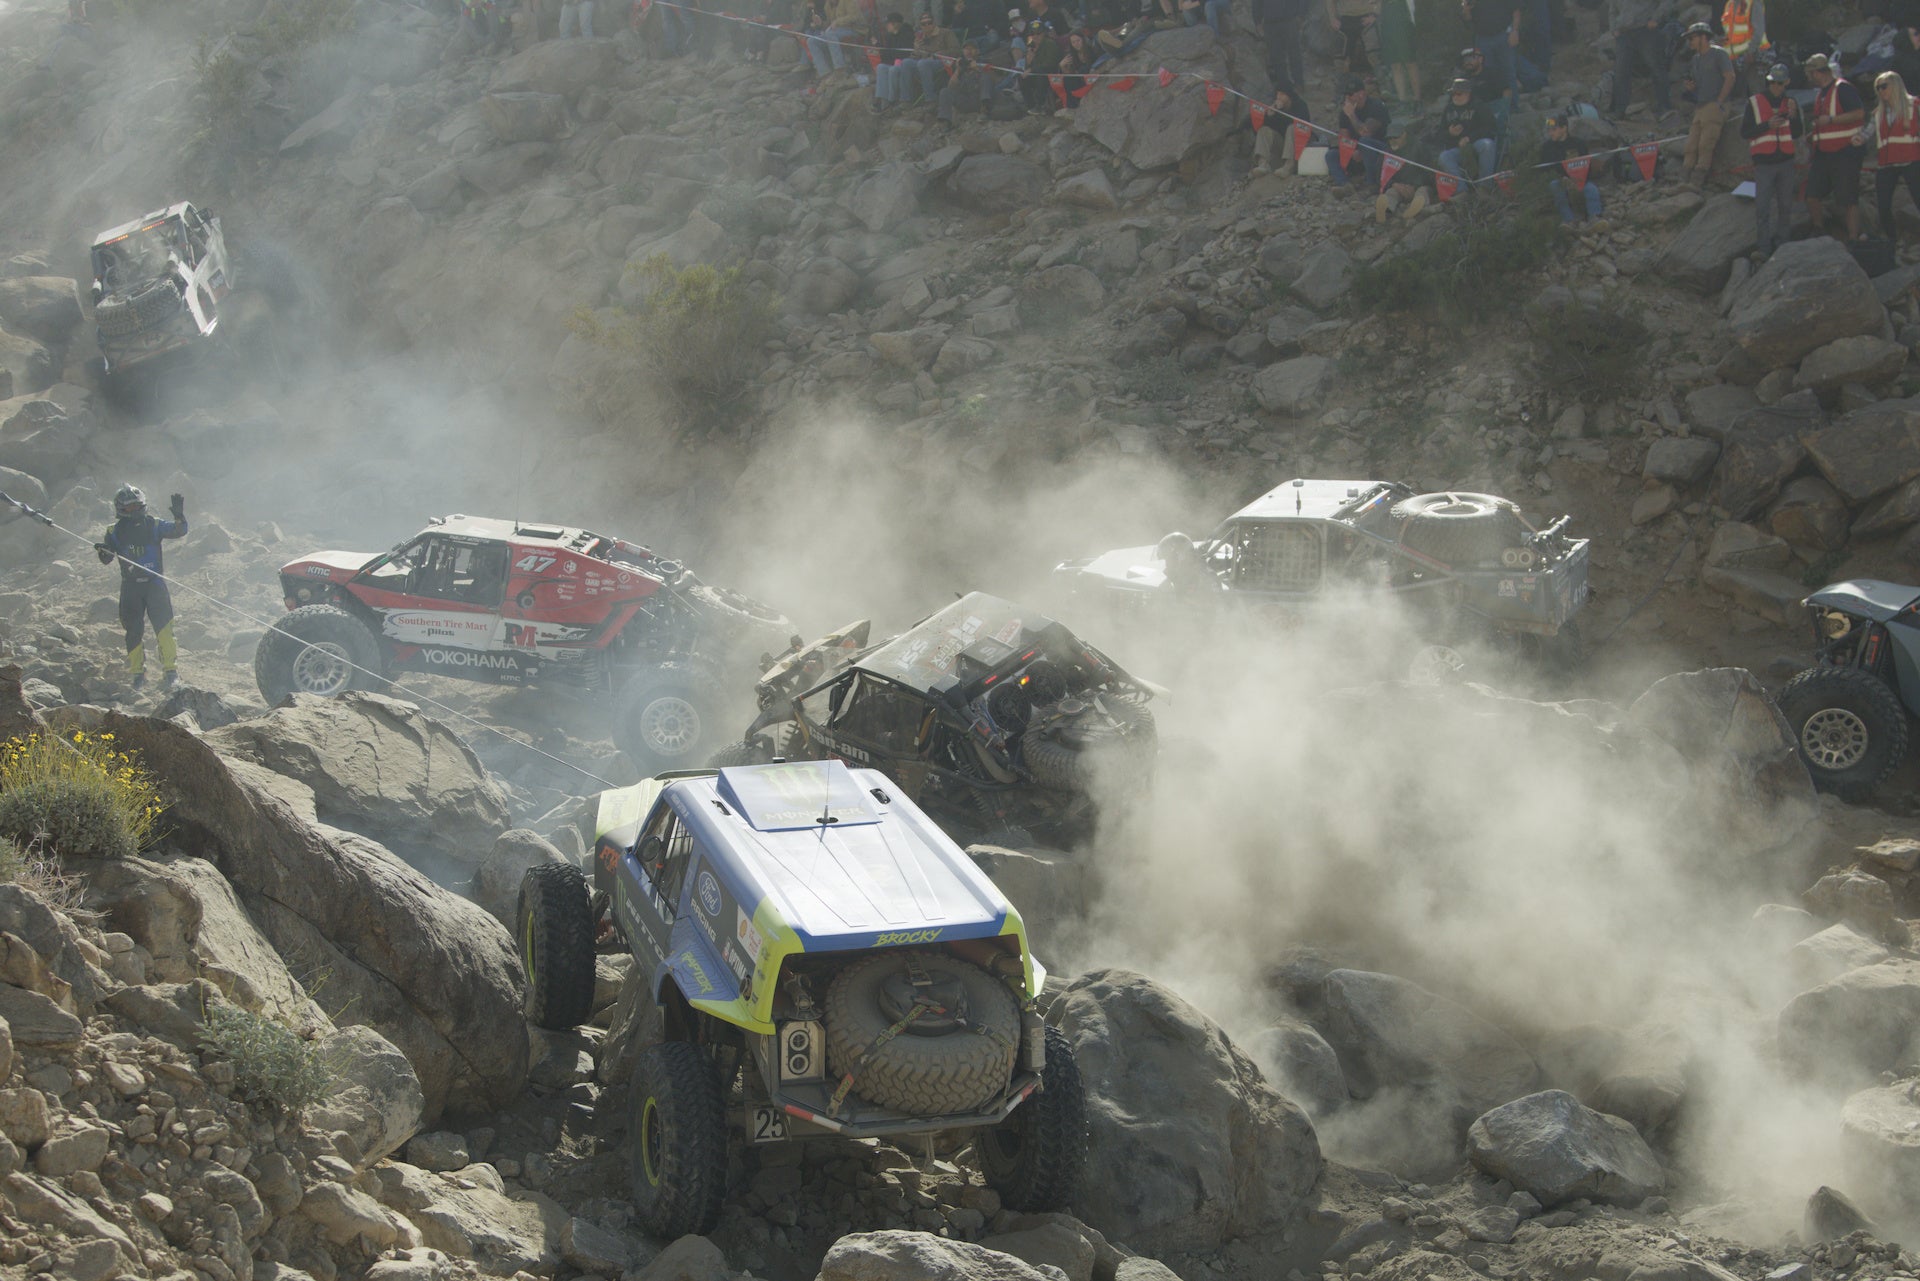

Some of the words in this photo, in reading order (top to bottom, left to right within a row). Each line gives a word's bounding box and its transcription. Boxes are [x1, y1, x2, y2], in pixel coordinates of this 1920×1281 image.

[515, 555, 557, 573] 47
[398, 616, 441, 627] Southern
[443, 619, 463, 629] Tire
[465, 622, 488, 631] Mart
[422, 648, 518, 670] YOKOHAMA
[701, 876, 719, 911] Ford
[690, 897, 717, 943] RACING
[871, 927, 944, 947] BROCKY
[681, 951, 714, 995] RAPTOR
